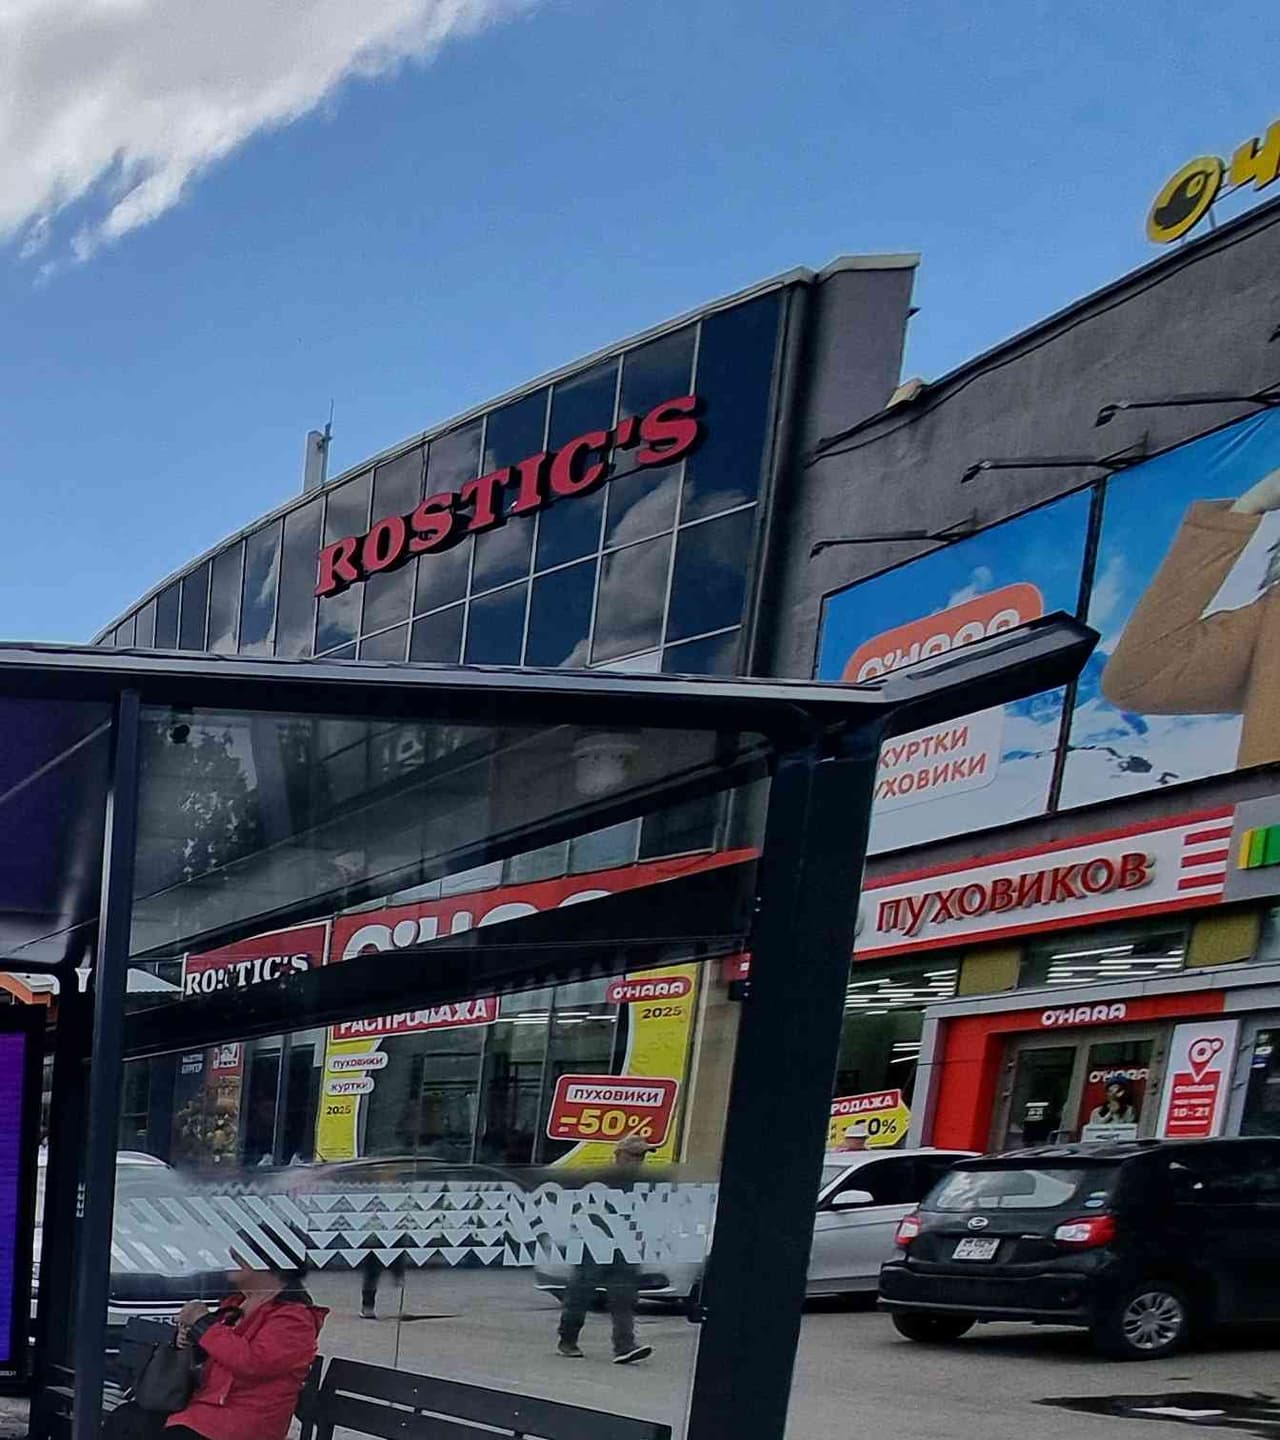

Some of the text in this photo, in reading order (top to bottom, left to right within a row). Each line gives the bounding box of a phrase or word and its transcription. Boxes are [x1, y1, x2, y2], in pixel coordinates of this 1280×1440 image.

[314, 394, 700, 597] ROSTIC'S
[877, 852, 1152, 936] ПУХОВИКОВ
[642, 1005, 683, 1020] 2025
[1041, 1003, 1127, 1026] O'HARA
[573, 1088, 660, 1103] ПУХОВИКИ
